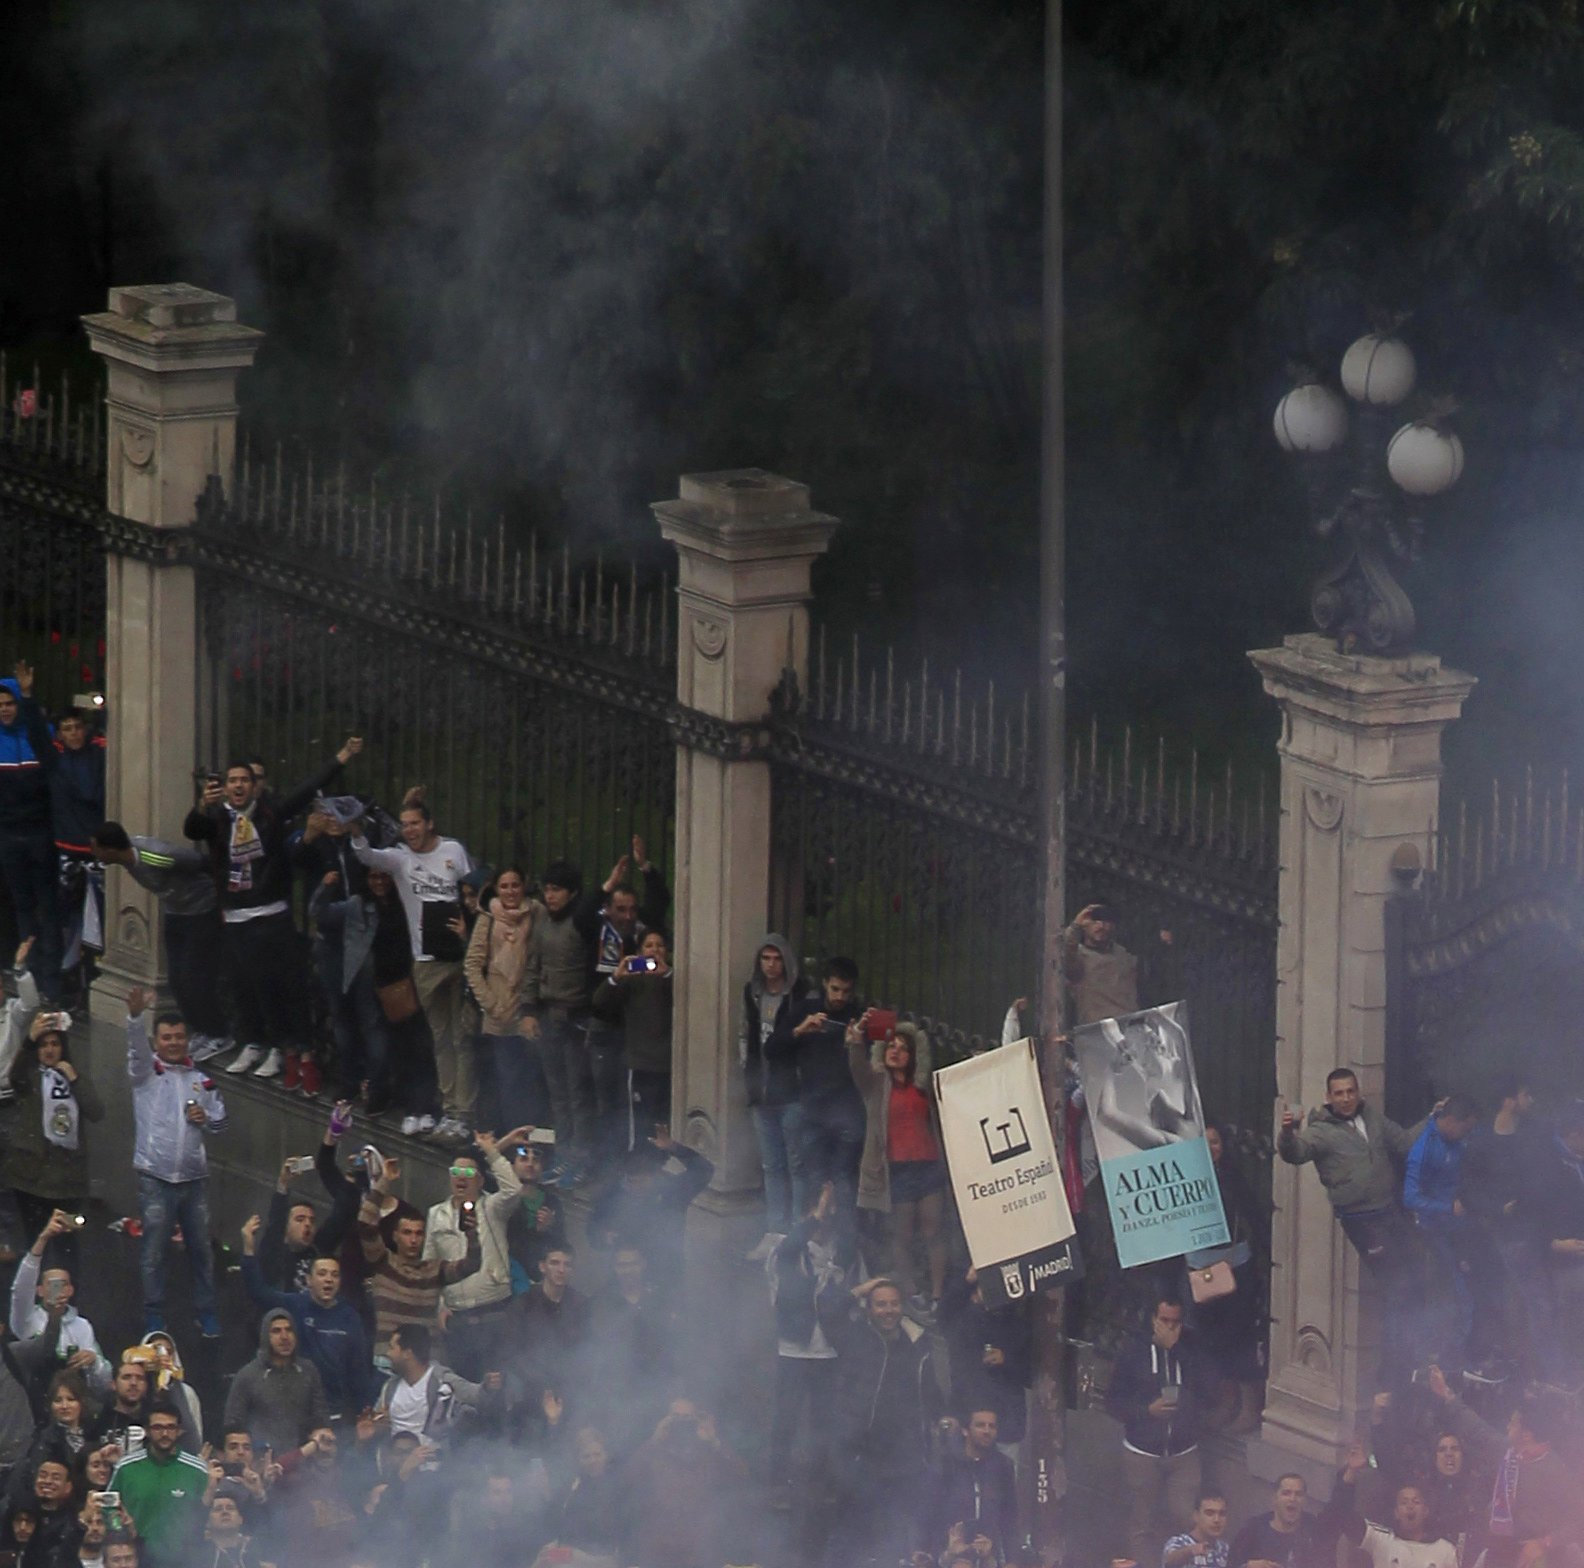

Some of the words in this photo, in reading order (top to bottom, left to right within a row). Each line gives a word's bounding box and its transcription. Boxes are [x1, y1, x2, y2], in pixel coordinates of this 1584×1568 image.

[967, 1174, 1015, 1201] Teatro
[1114, 1160, 1186, 1196] ALMA
[1002, 1197, 1029, 1214] DESDE
[1118, 1205, 1130, 1220] Y
[1133, 1177, 1216, 1216] CUERPO
